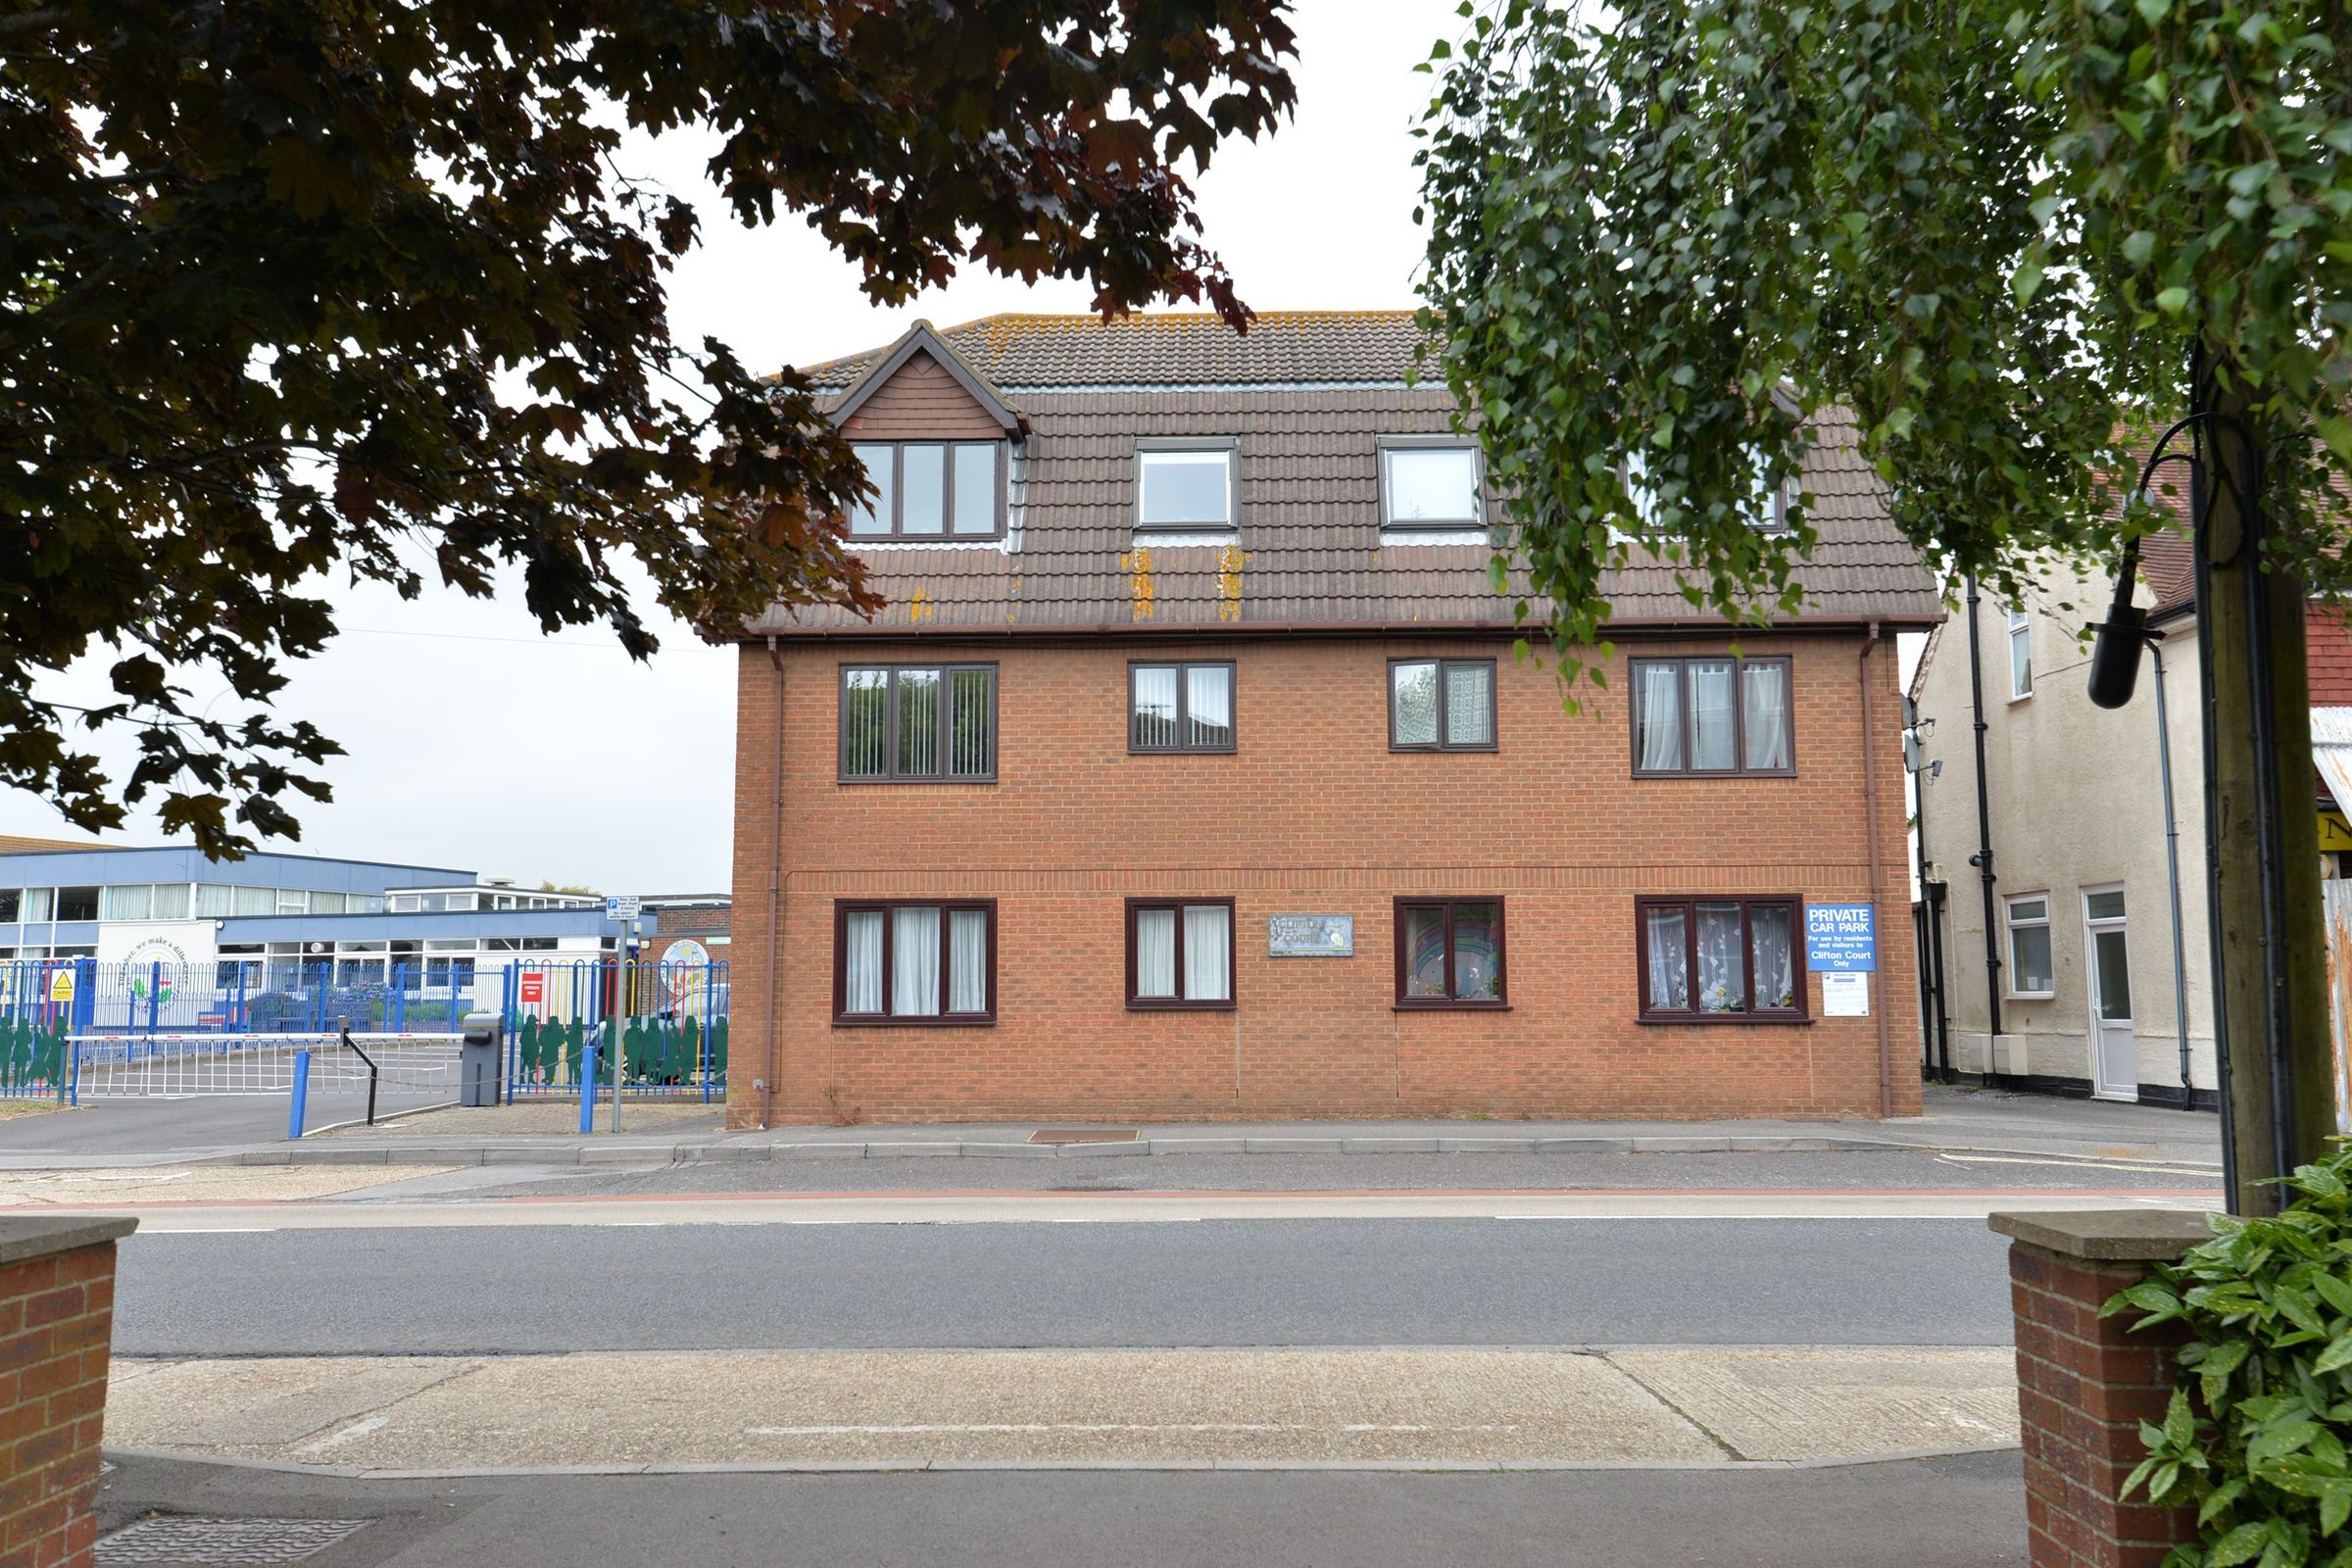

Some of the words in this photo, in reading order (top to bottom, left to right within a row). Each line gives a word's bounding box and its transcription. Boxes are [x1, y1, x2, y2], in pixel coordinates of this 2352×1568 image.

[1808, 908, 1870, 922] PRIVATE
[1810, 922, 1835, 933] CAR
[1838, 922, 1870, 933] PARK
[135, 941, 146, 950] we
[148, 936, 168, 945] make
[1811, 951, 1842, 959] Clifton
[1844, 951, 1872, 959] Court
